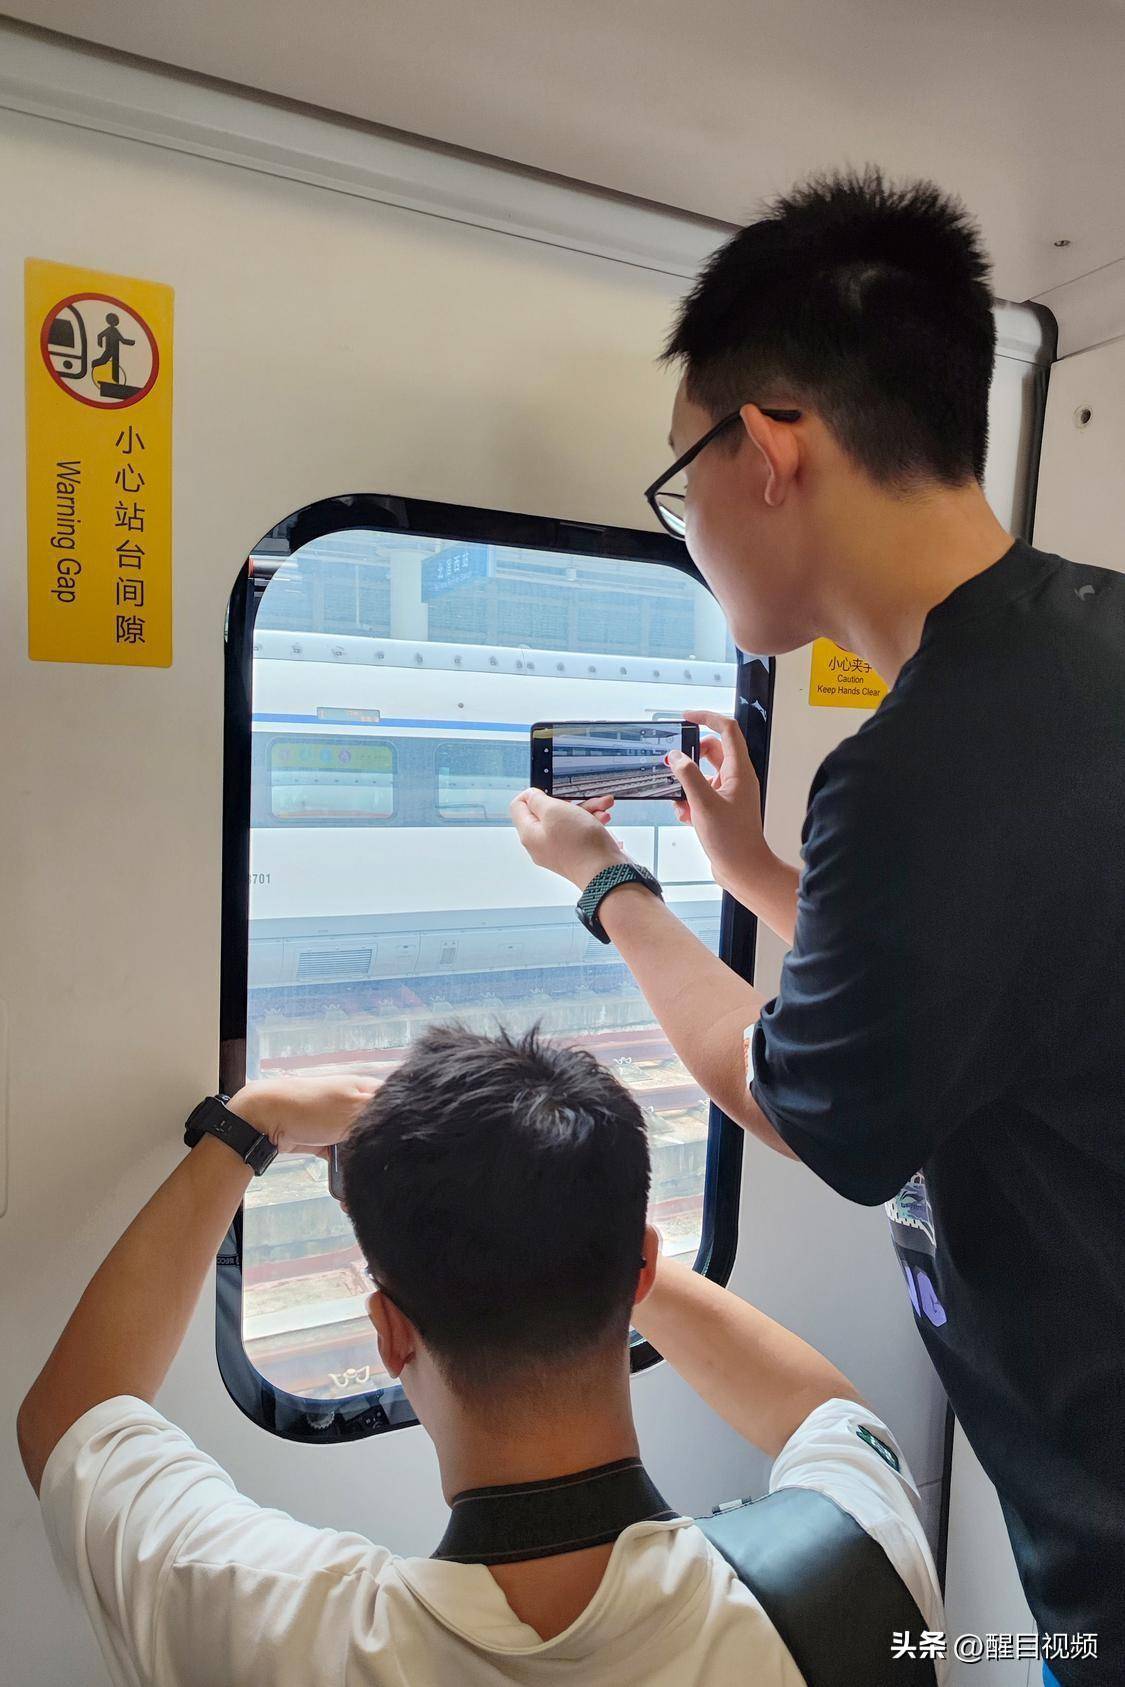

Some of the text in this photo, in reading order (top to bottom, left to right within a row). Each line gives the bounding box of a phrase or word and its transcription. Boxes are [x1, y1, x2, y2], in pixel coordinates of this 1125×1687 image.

[51, 460, 82, 603] Warning Gap
[115, 425, 146, 644] 小心站台间隙
[837, 674, 864, 684] Caution
[817, 685, 880, 697] Keep Hands Clear
[250, 873, 271, 885] 701
